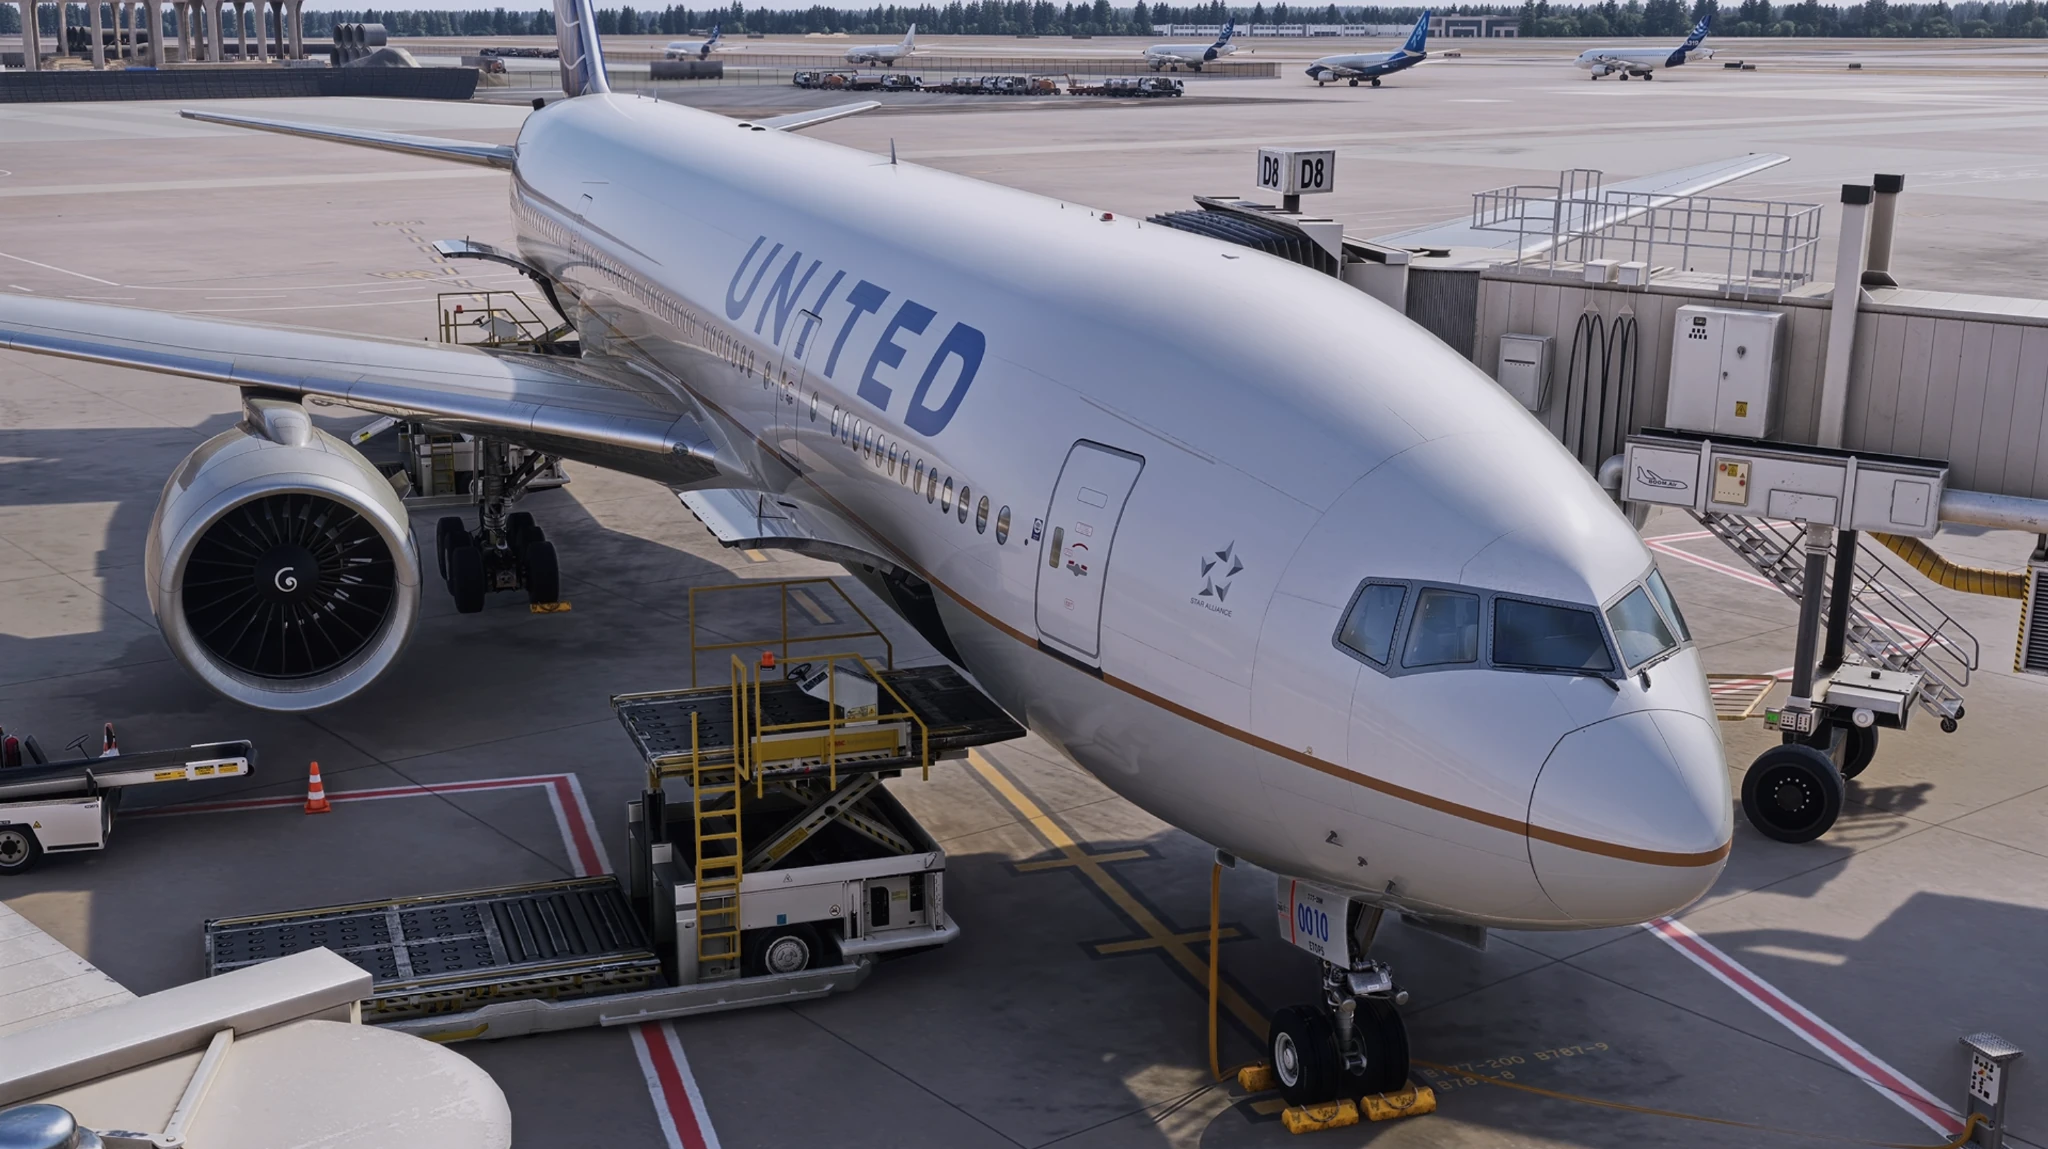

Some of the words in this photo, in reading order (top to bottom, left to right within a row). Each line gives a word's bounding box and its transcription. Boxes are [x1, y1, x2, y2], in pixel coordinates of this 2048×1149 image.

[1263, 156, 1279, 187] D8
[1301, 158, 1324, 188] D8
[725, 235, 986, 437] UNITED
[1190, 597, 1204, 606] STAR
[1205, 603, 1232, 617] ALLIANCE
[1298, 903, 1328, 942] 0010
[1308, 940, 1325, 956] ETOPS
[1533, 1042, 1609, 1061] B787-9
[1436, 1070, 1515, 1090] B78-8
